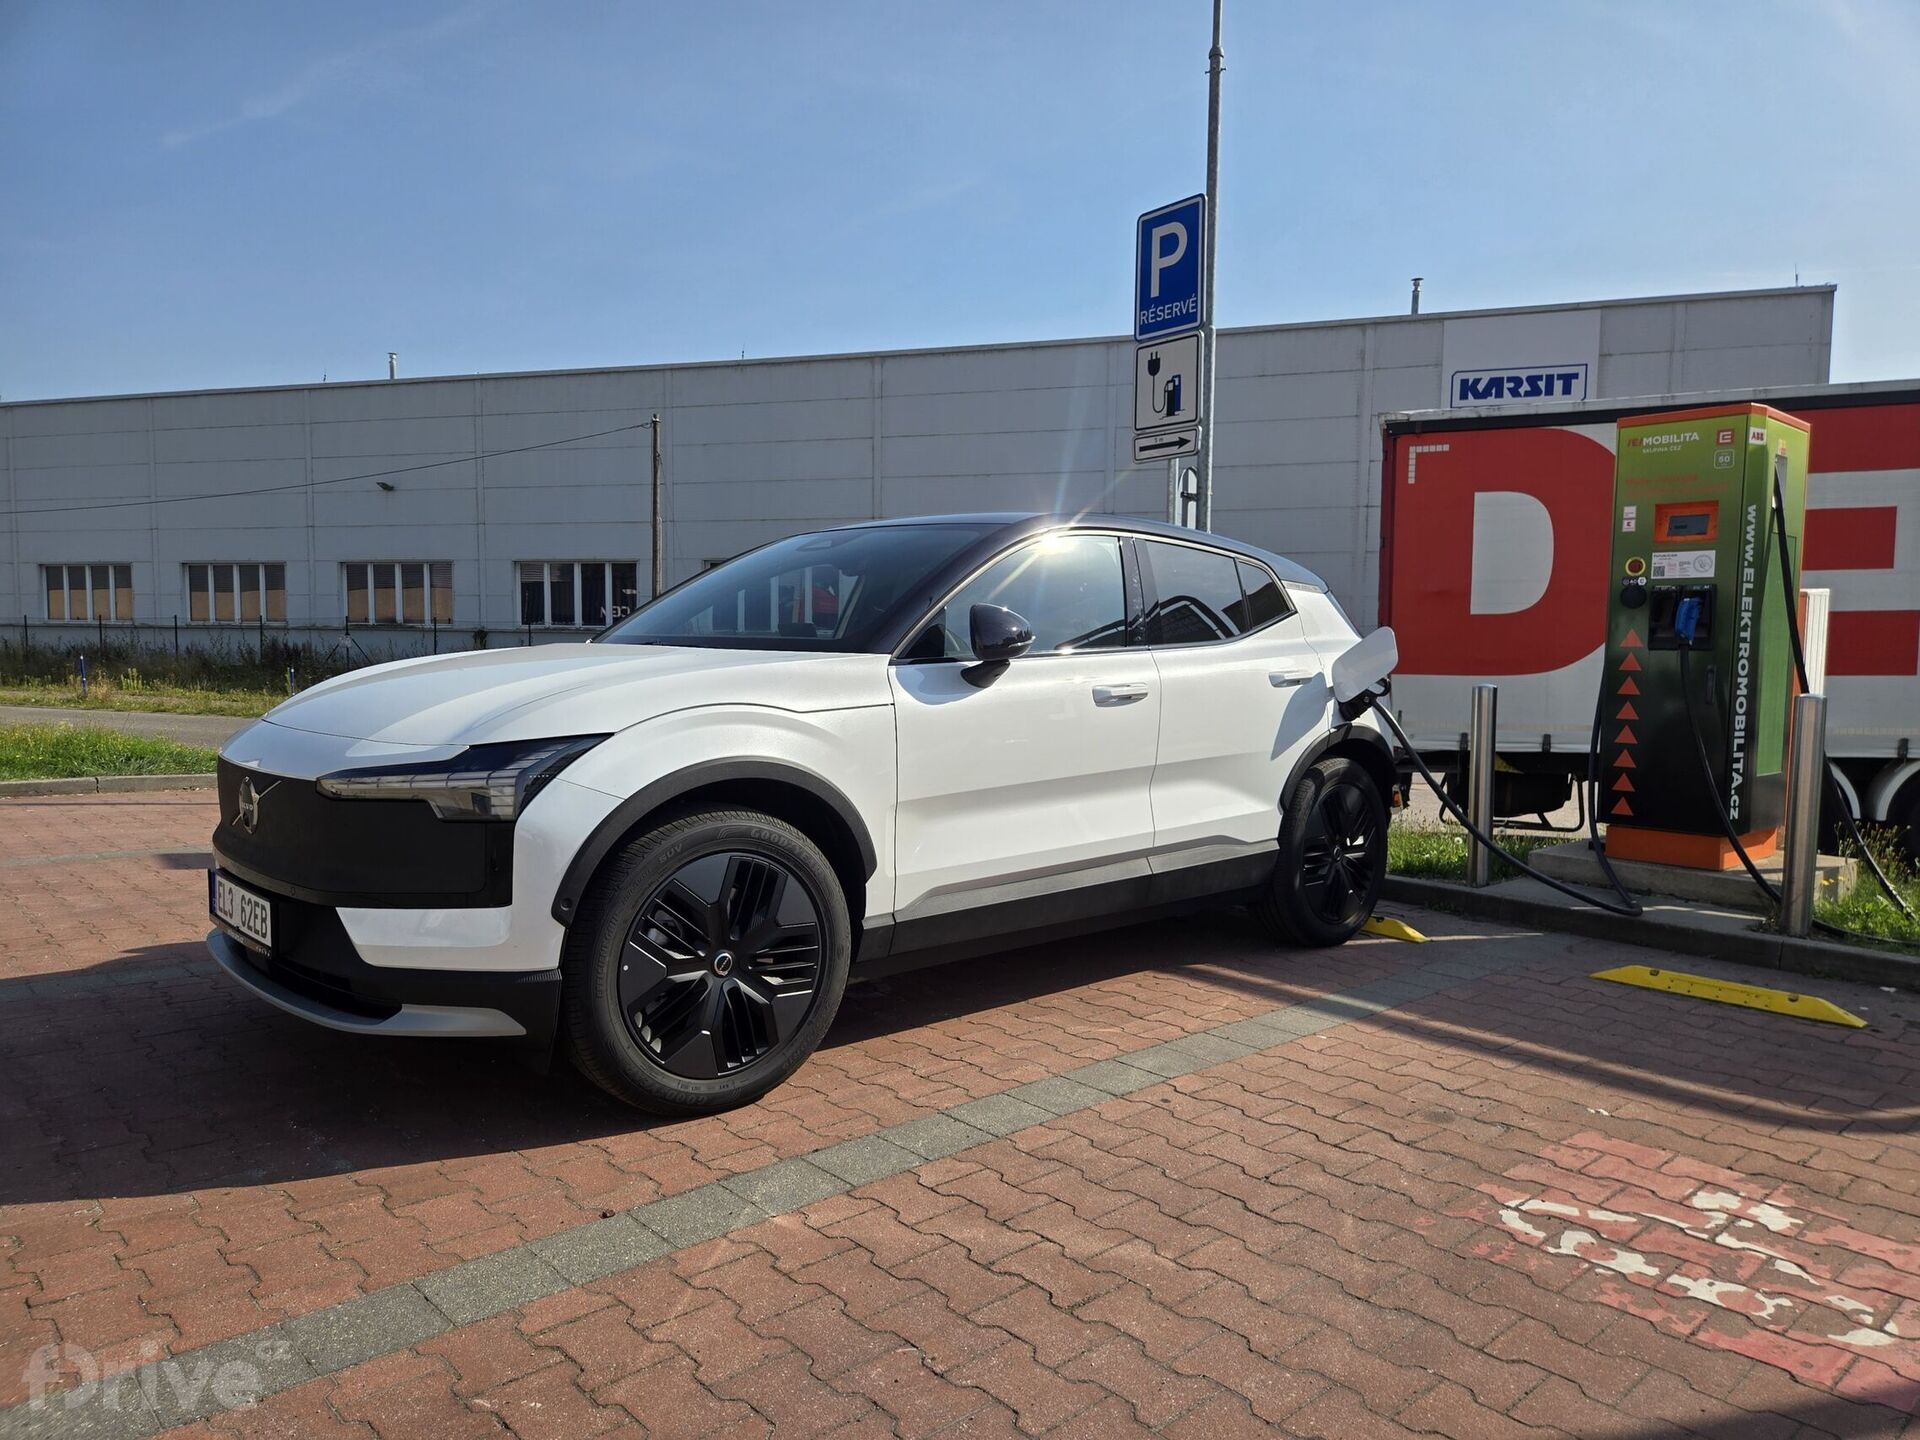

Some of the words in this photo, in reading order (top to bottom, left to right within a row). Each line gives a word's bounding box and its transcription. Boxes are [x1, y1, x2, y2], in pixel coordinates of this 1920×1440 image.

[1151, 222, 1187, 298] P
[1140, 293, 1197, 325] RÉSERVÉ
[1460, 373, 1579, 400] KARSIT
[1751, 432, 1764, 441] ABB
[656, 842, 683, 864] SUV
[218, 880, 233, 919] EL3
[240, 894, 268, 939] 62EB
